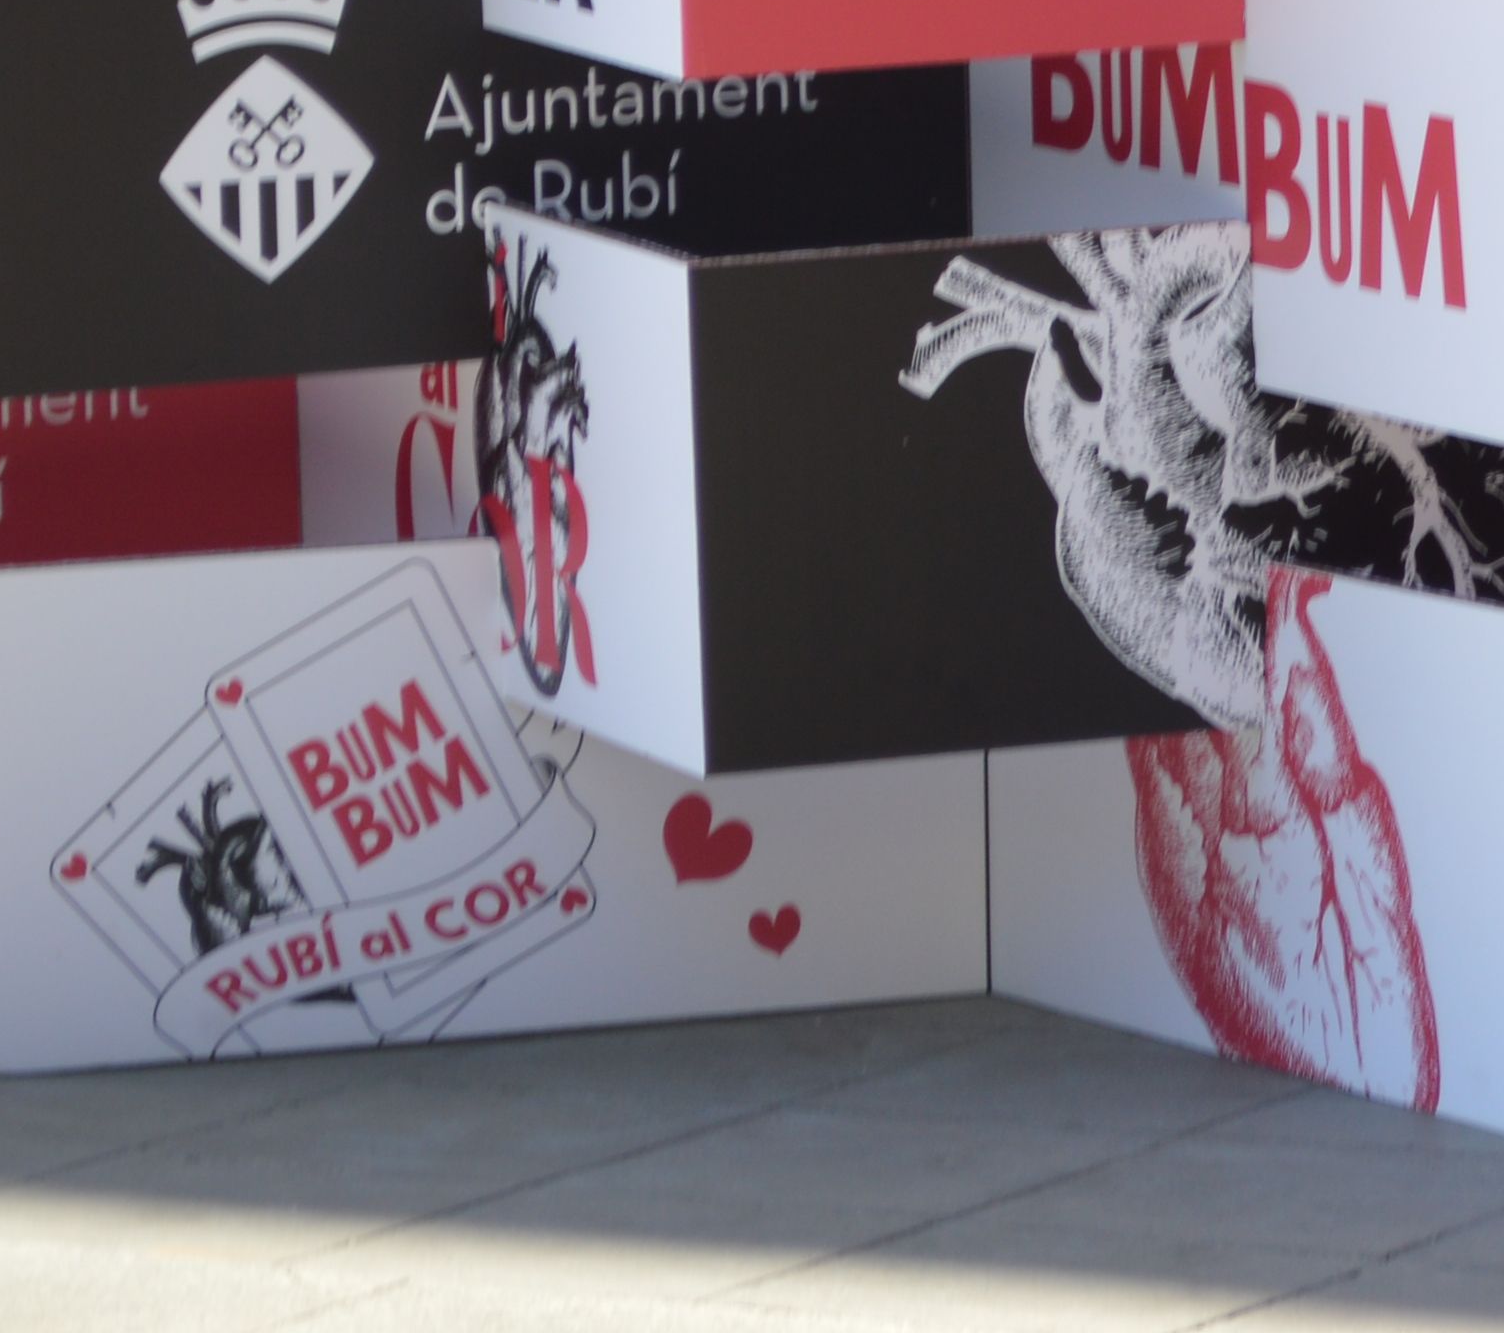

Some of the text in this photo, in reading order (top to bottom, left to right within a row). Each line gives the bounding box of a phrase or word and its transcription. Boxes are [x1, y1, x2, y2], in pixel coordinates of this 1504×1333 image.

[424, 66, 819, 156] Ajuntament
[533, 149, 683, 223] Rubí
[205, 910, 341, 1015] RUBÍ
[424, 858, 547, 943] COR
